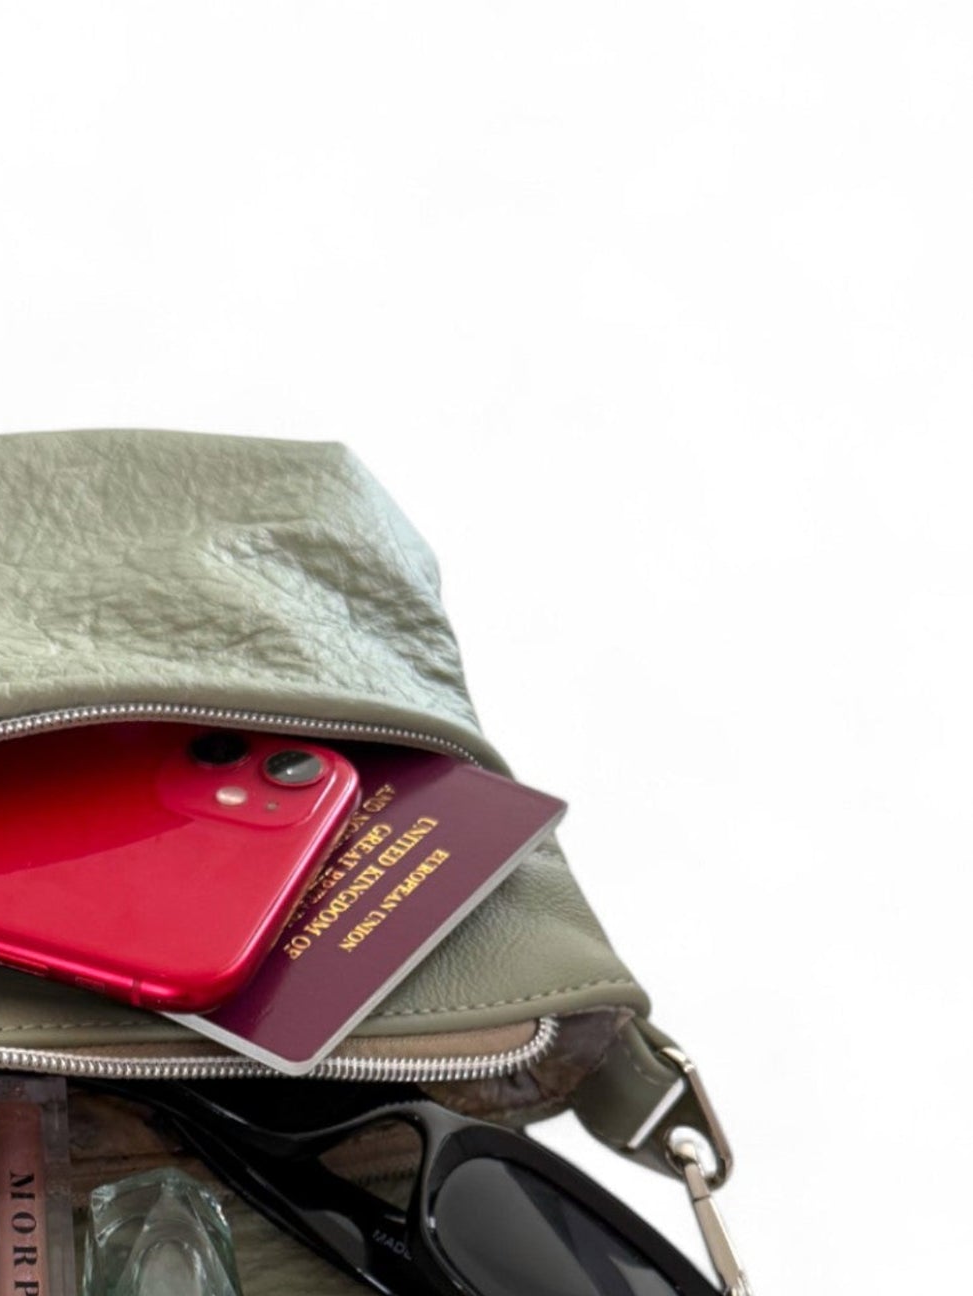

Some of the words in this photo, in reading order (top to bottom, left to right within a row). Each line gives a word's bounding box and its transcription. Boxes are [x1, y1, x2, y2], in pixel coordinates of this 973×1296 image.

[338, 824, 393, 871] GREAT
[378, 817, 439, 867] UNITED
[304, 865, 385, 936] KINGDOM
[380, 848, 451, 912] EUROPEAN
[283, 935, 311, 960] OF
[338, 911, 388, 952] UNION
